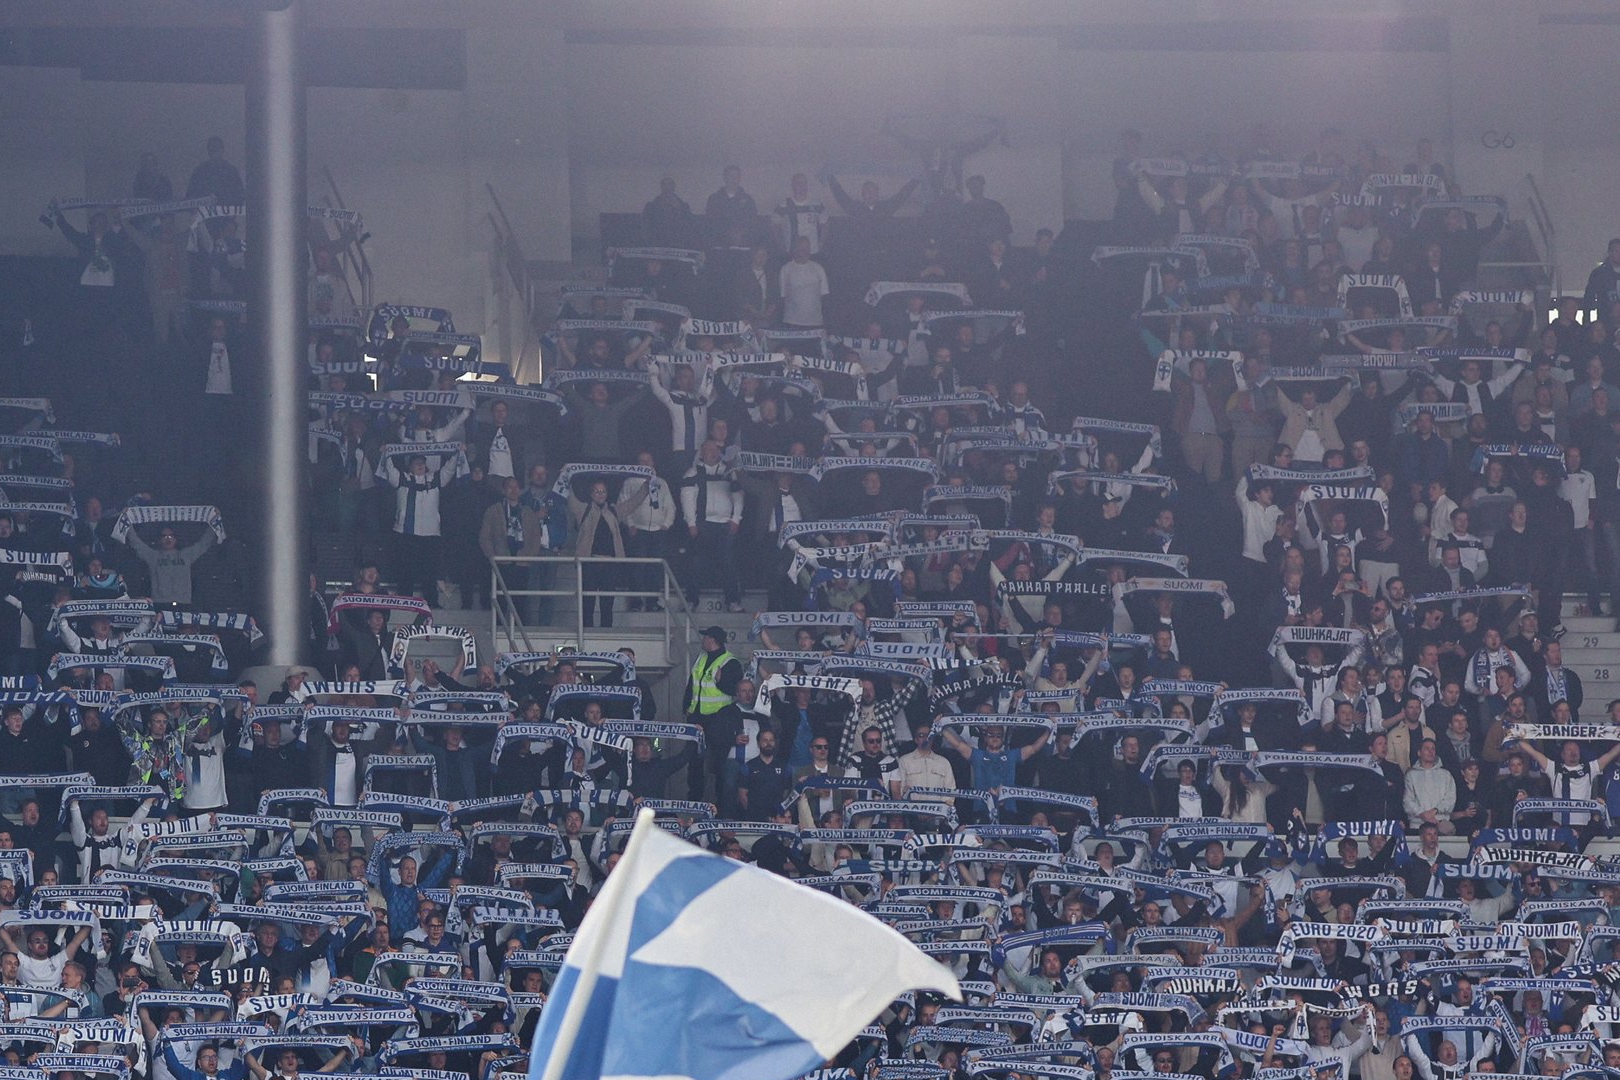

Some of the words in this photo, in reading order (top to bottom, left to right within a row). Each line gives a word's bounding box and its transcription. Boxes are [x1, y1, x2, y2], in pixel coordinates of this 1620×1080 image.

[692, 320, 742, 334] SUOMI
[802, 355, 854, 372] SUOMI
[1310, 485, 1377, 499] SUOMI
[6, 550, 59, 564] SUOMI
[1163, 580, 1203, 590] SUOMI
[777, 613, 841, 625] SUOMI
[1291, 627, 1351, 641] HUUHKAJAT
[129, 691, 163, 700] SUOMI
[169, 688, 210, 699] FINLAND
[1542, 725, 1597, 737] DANGER
[1337, 820, 1396, 836] SUOMI
[19, 909, 92, 921] SUOMI
[233, 905, 268, 915] SUOMI
[269, 909, 321, 922] FINLAND
[1292, 924, 1333, 938] EURO
[1337, 925, 1376, 940] 2020
[1456, 937, 1522, 951] SUOMI
[408, 1039, 441, 1050] SUOMI
[447, 1035, 492, 1046] FINLAND
